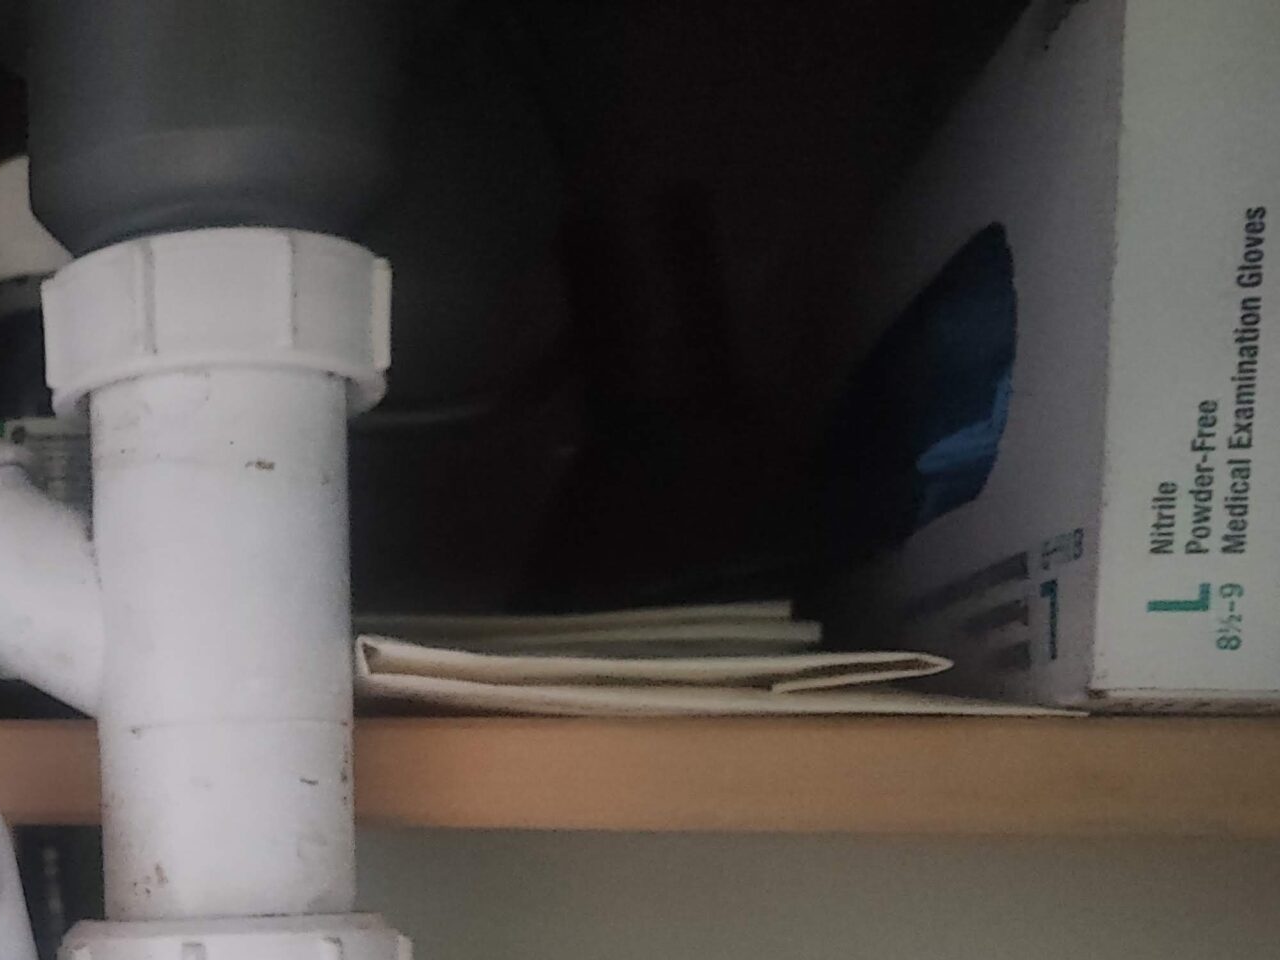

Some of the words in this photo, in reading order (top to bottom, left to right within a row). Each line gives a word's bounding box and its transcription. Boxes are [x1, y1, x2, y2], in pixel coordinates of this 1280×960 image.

[1235, 206, 1267, 289] Gloves
[1226, 296, 1263, 451] Examination
[1149, 481, 1179, 555] Nitrile
[1184, 399, 1218, 555] Powder-Free
[1220, 458, 1252, 555] Medical
[1146, 582, 1212, 613] L
